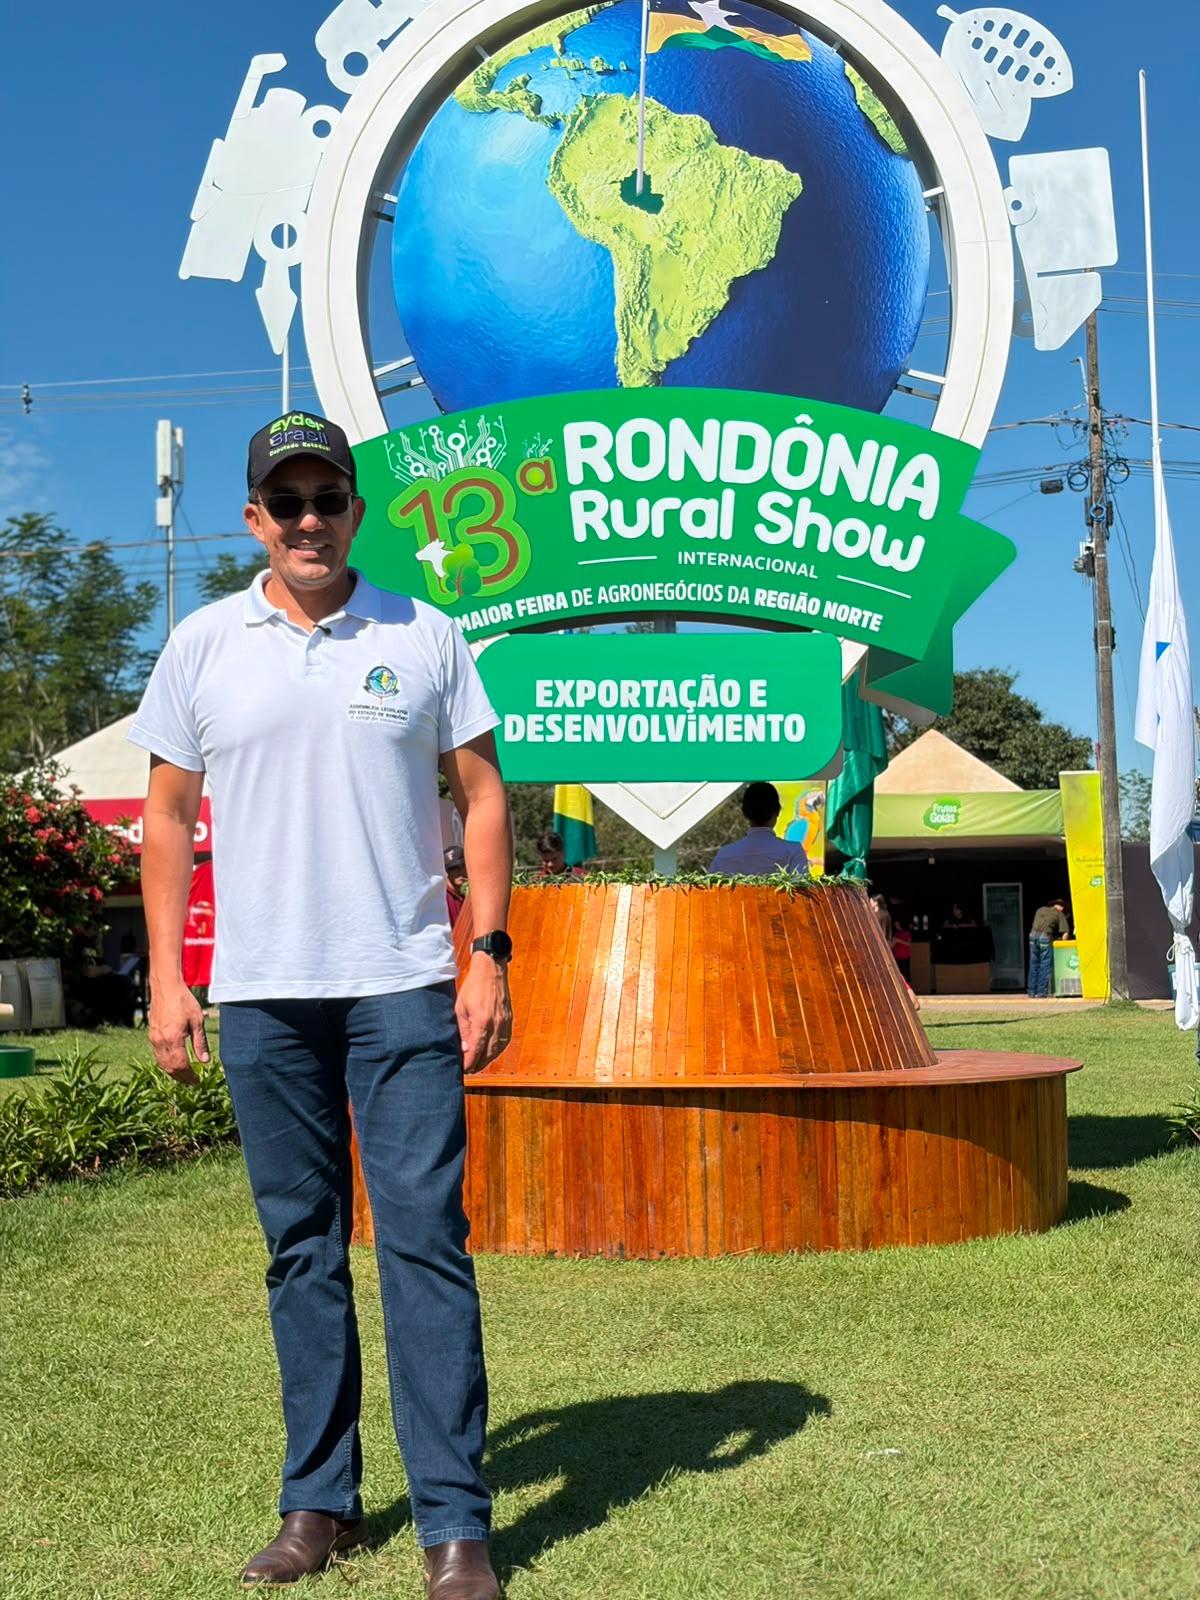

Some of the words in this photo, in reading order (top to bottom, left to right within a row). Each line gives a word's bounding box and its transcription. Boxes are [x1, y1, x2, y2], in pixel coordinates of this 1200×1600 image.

[563, 413, 940, 520] RONDÔNIA
[569, 488, 736, 543] Rural
[754, 491, 925, 572] Show
[677, 551, 818, 579] INTERNACIONAL
[453, 603, 514, 634] MAIOR
[515, 592, 569, 618] FEIRA
[571, 588, 593, 607] DE
[598, 580, 724, 605] AGRONEGÓCIOS
[727, 586, 750, 605] DA
[754, 588, 821, 616] REGIÃO
[823, 601, 884, 632] NORTE
[535, 674, 741, 713] EXPORTAÇÃO
[749, 679, 768, 708] E
